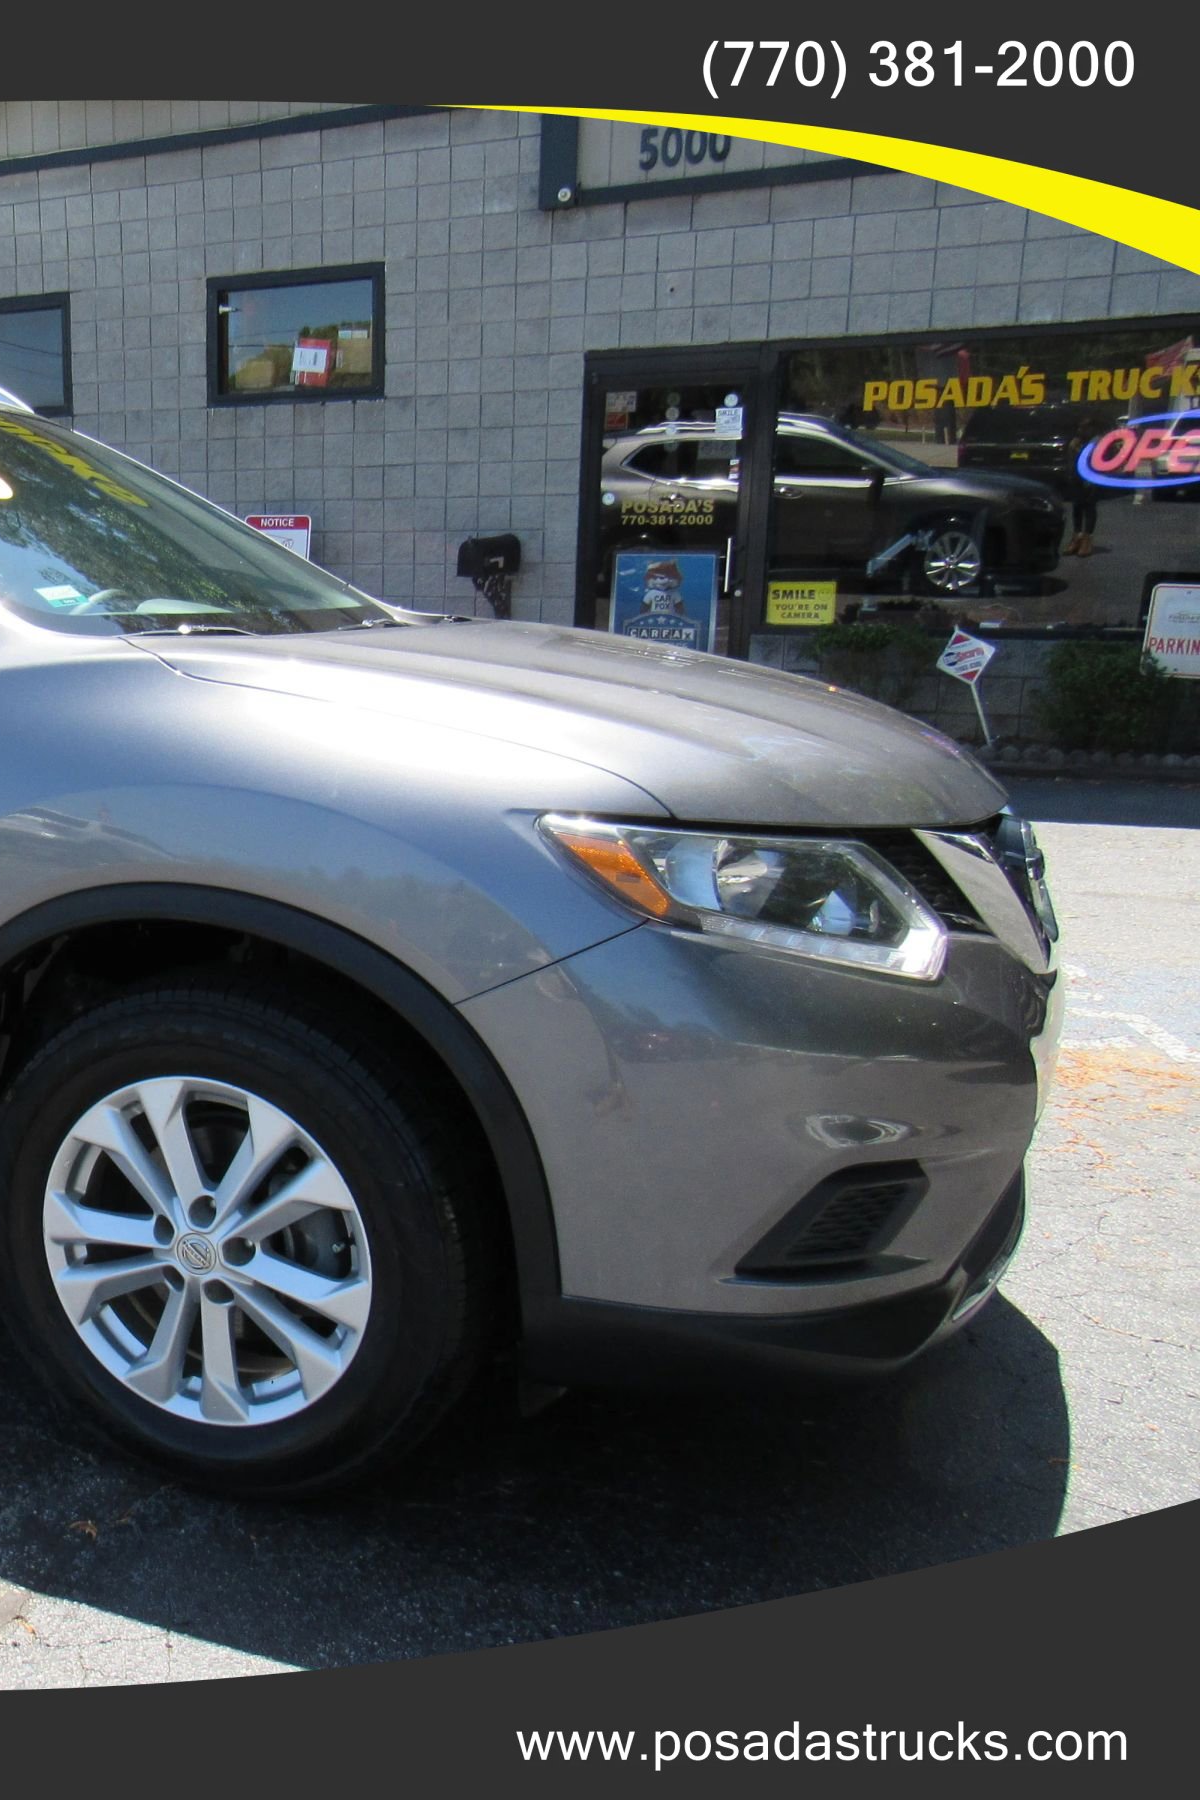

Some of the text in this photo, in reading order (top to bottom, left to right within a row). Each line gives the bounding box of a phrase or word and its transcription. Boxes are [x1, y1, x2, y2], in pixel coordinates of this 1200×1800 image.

[639, 127, 731, 171] 5000
[862, 364, 1200, 412] POSADA'S TRUCK
[621, 500, 714, 513] POSADA'S
[260, 518, 294, 527] NOTICE
[621, 515, 713, 525] 770-381-2000
[771, 589, 816, 600] SMILE
[630, 628, 694, 640] CARFAX
